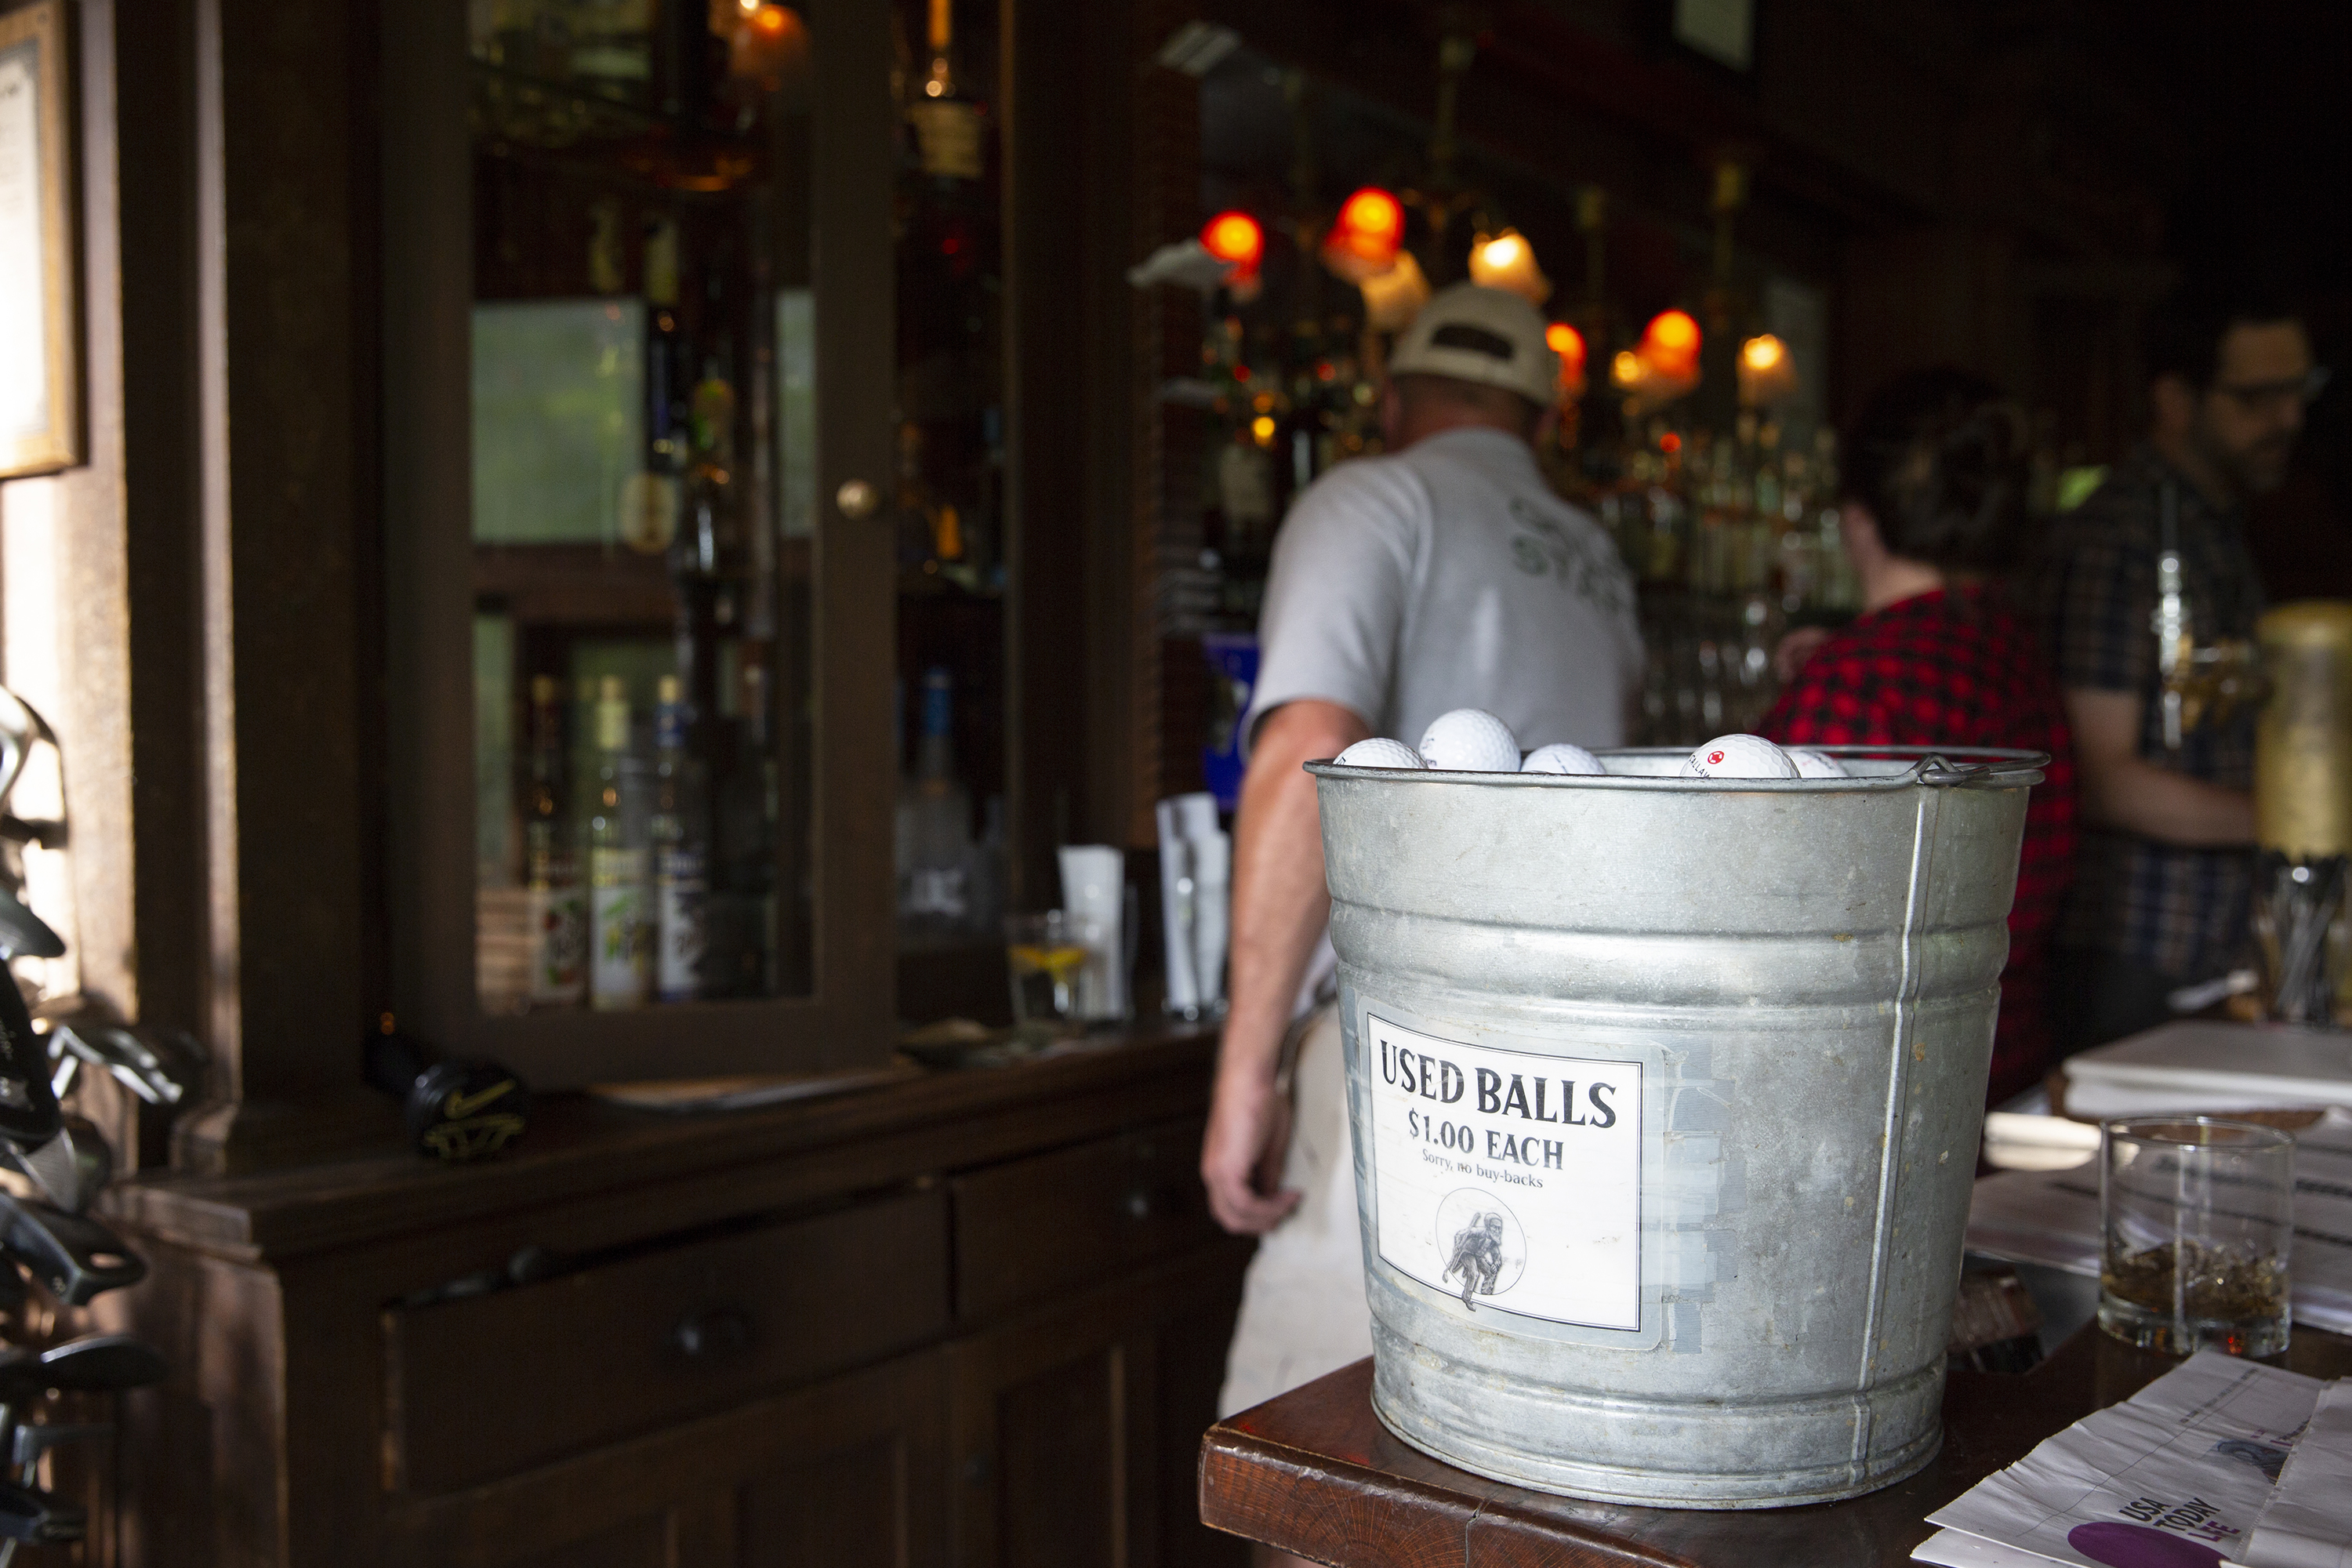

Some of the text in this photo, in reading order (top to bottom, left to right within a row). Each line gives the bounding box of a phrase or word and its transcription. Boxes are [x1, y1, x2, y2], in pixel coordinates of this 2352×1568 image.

[1380, 1039, 1617, 1128] USED BALLS
[1408, 1108, 1565, 1171] $1.00 EACH
[1422, 1149, 1544, 1189] Sorry, no buy-backs
[2118, 1497, 2172, 1522] USA
[2153, 1497, 2221, 1531] TODAY
[2187, 1520, 2241, 1542] LFE
